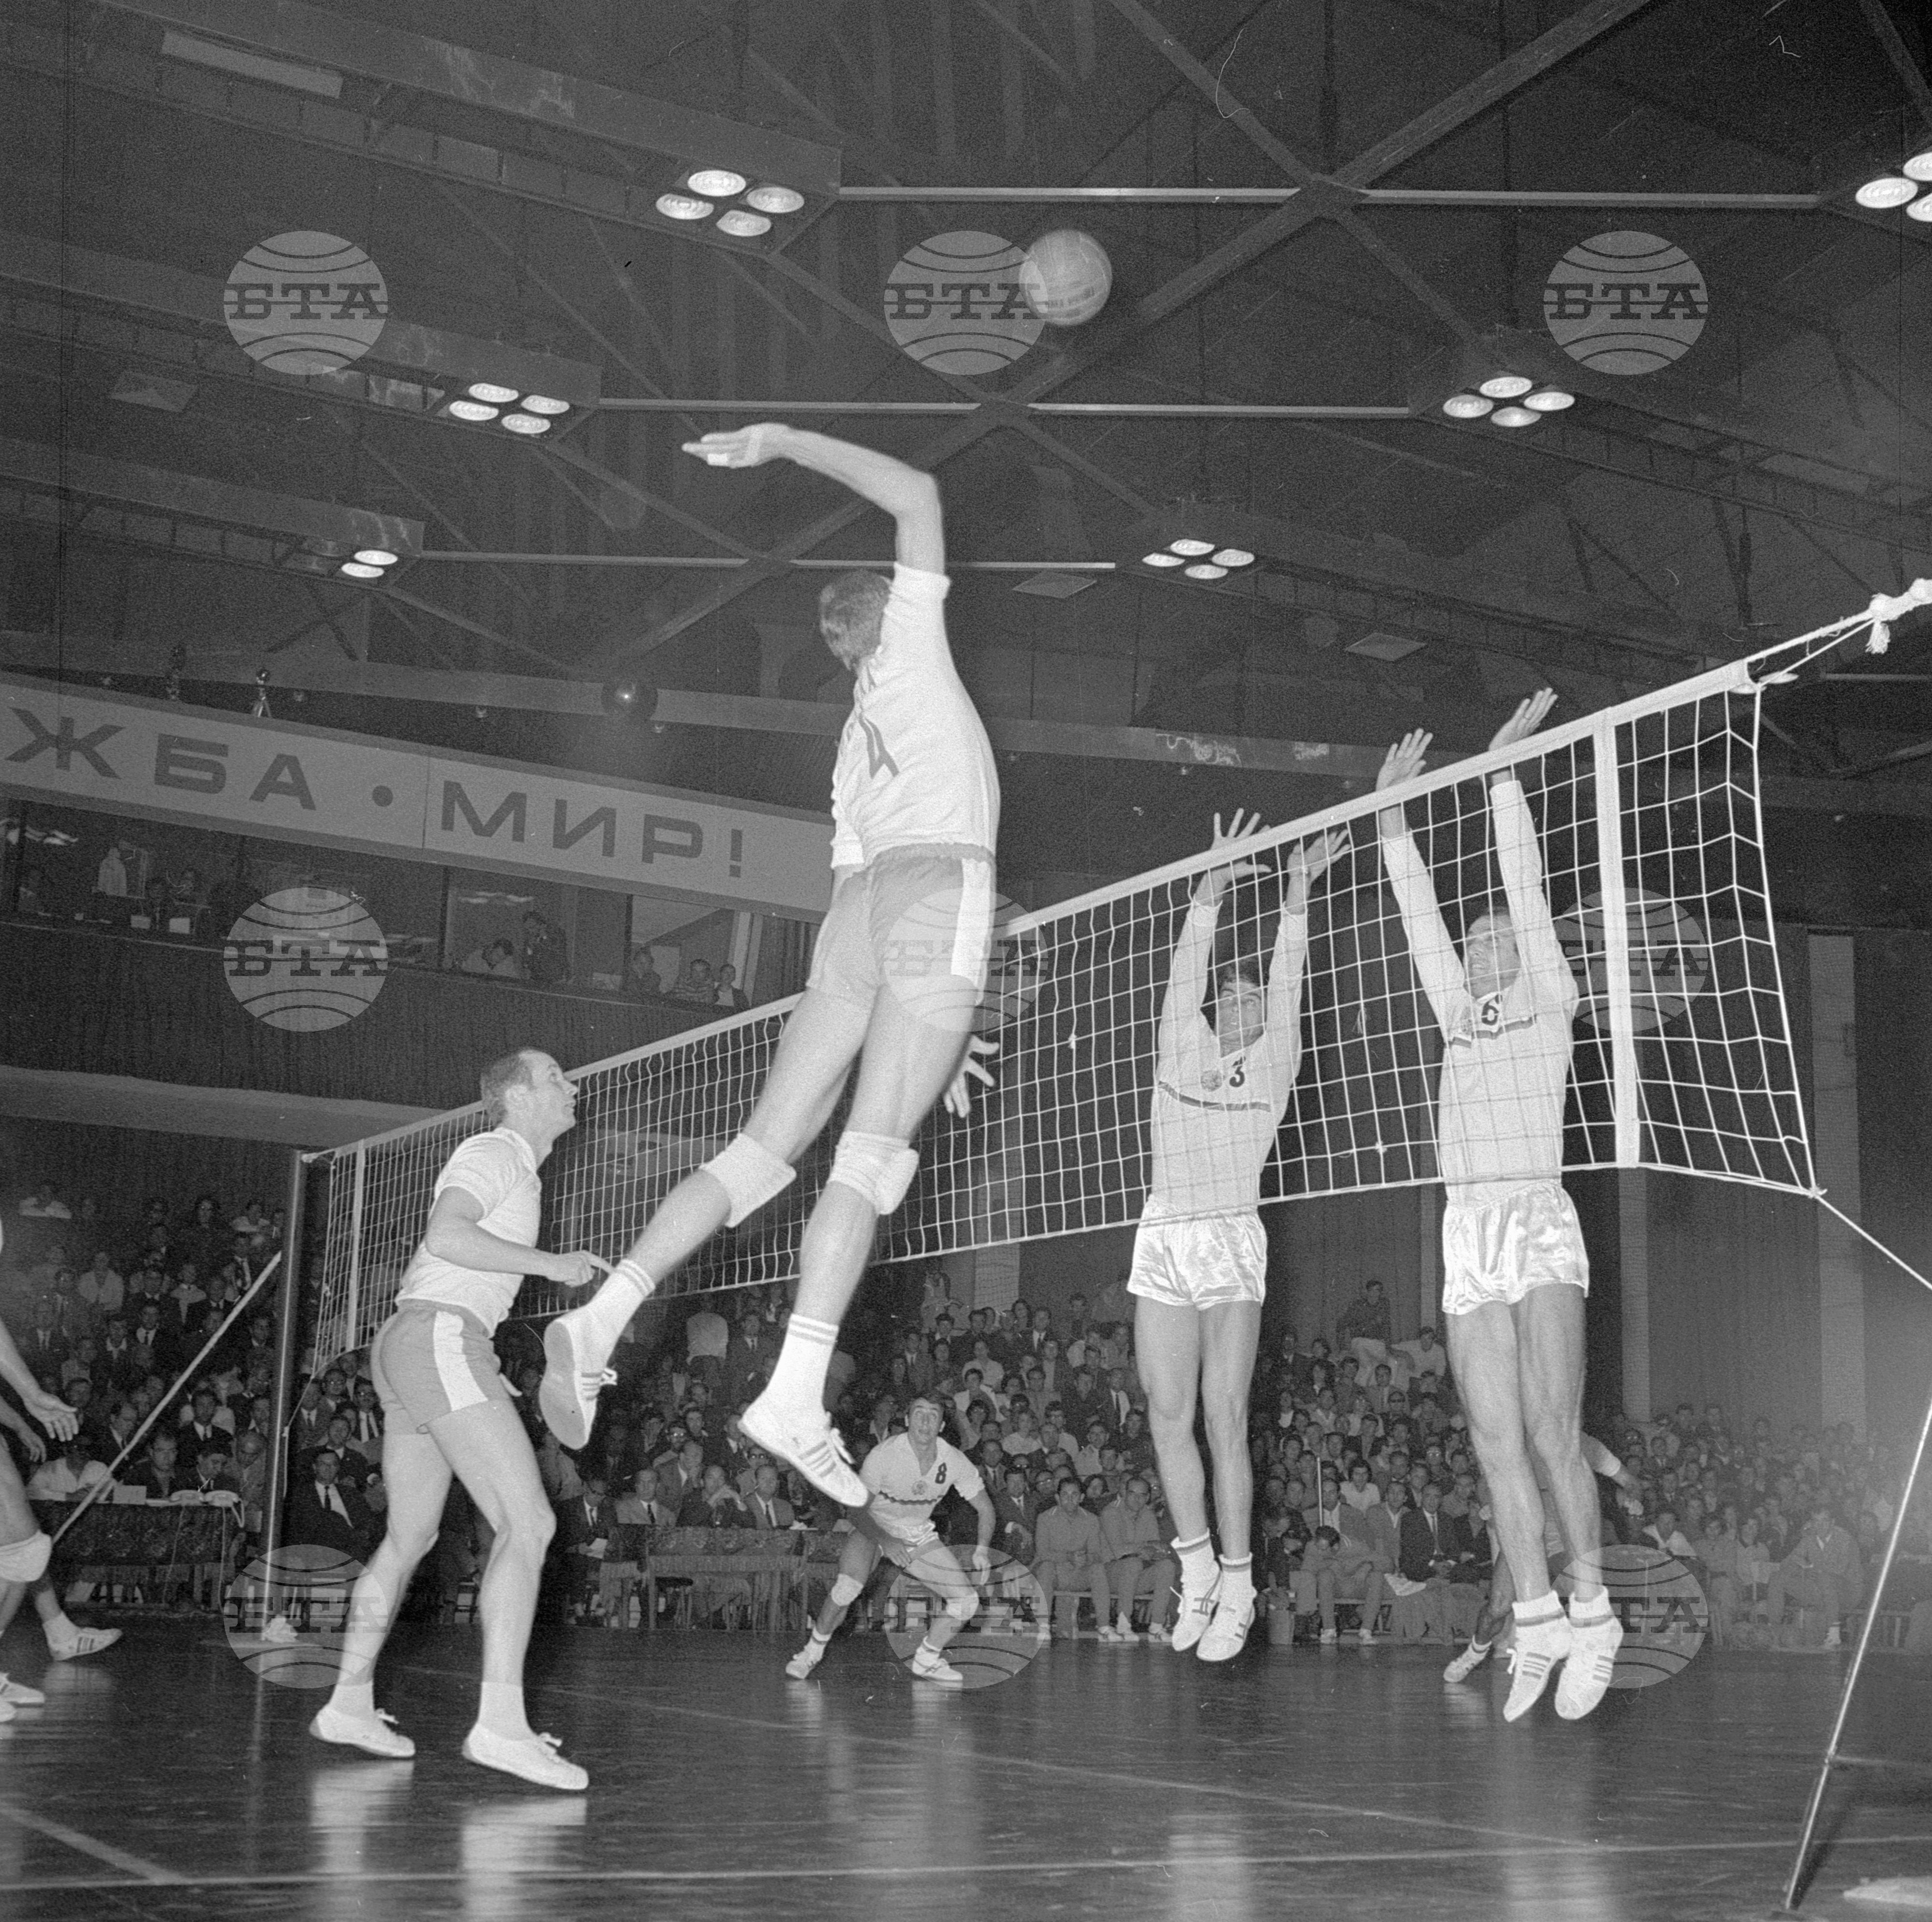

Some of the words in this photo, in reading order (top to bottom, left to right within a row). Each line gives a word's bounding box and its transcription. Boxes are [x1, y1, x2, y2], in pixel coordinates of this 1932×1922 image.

[5, 707, 317, 811] ЖБА
[441, 780, 742, 877] МИР!
[1481, 994, 1503, 1026] 6
[1229, 1056, 1247, 1088] 3
[935, 1462, 948, 1484] 8
